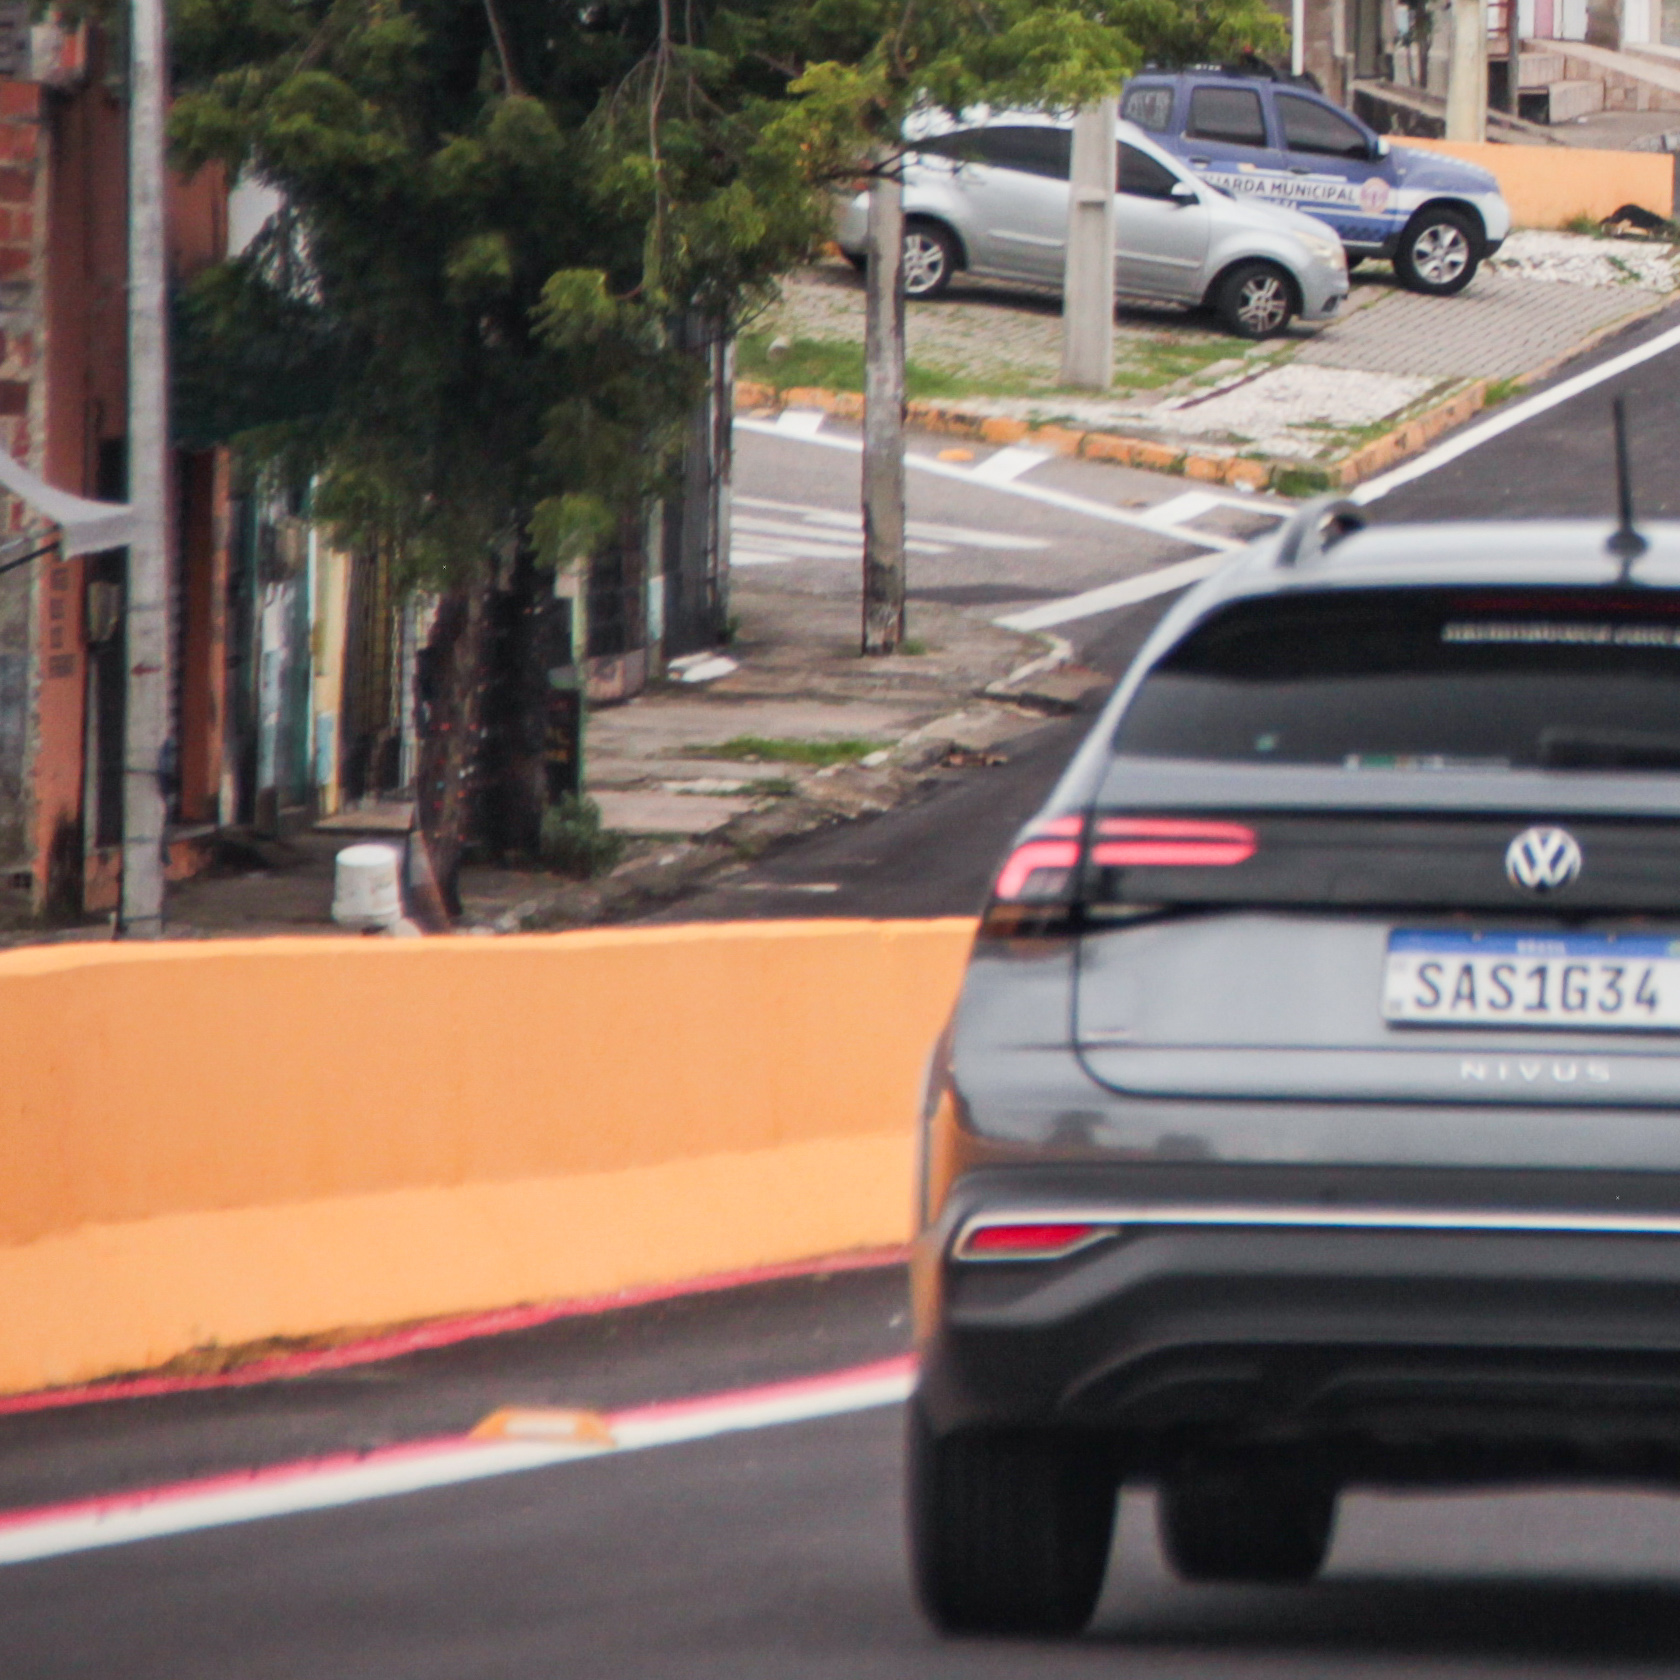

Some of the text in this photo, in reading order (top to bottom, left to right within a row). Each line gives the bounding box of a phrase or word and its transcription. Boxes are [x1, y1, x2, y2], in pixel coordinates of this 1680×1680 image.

[1270, 182, 1355, 202] MUNICIPAL
[1414, 962, 1659, 1013] SAS1G34
[1460, 1060, 1610, 1083] NIVUS
